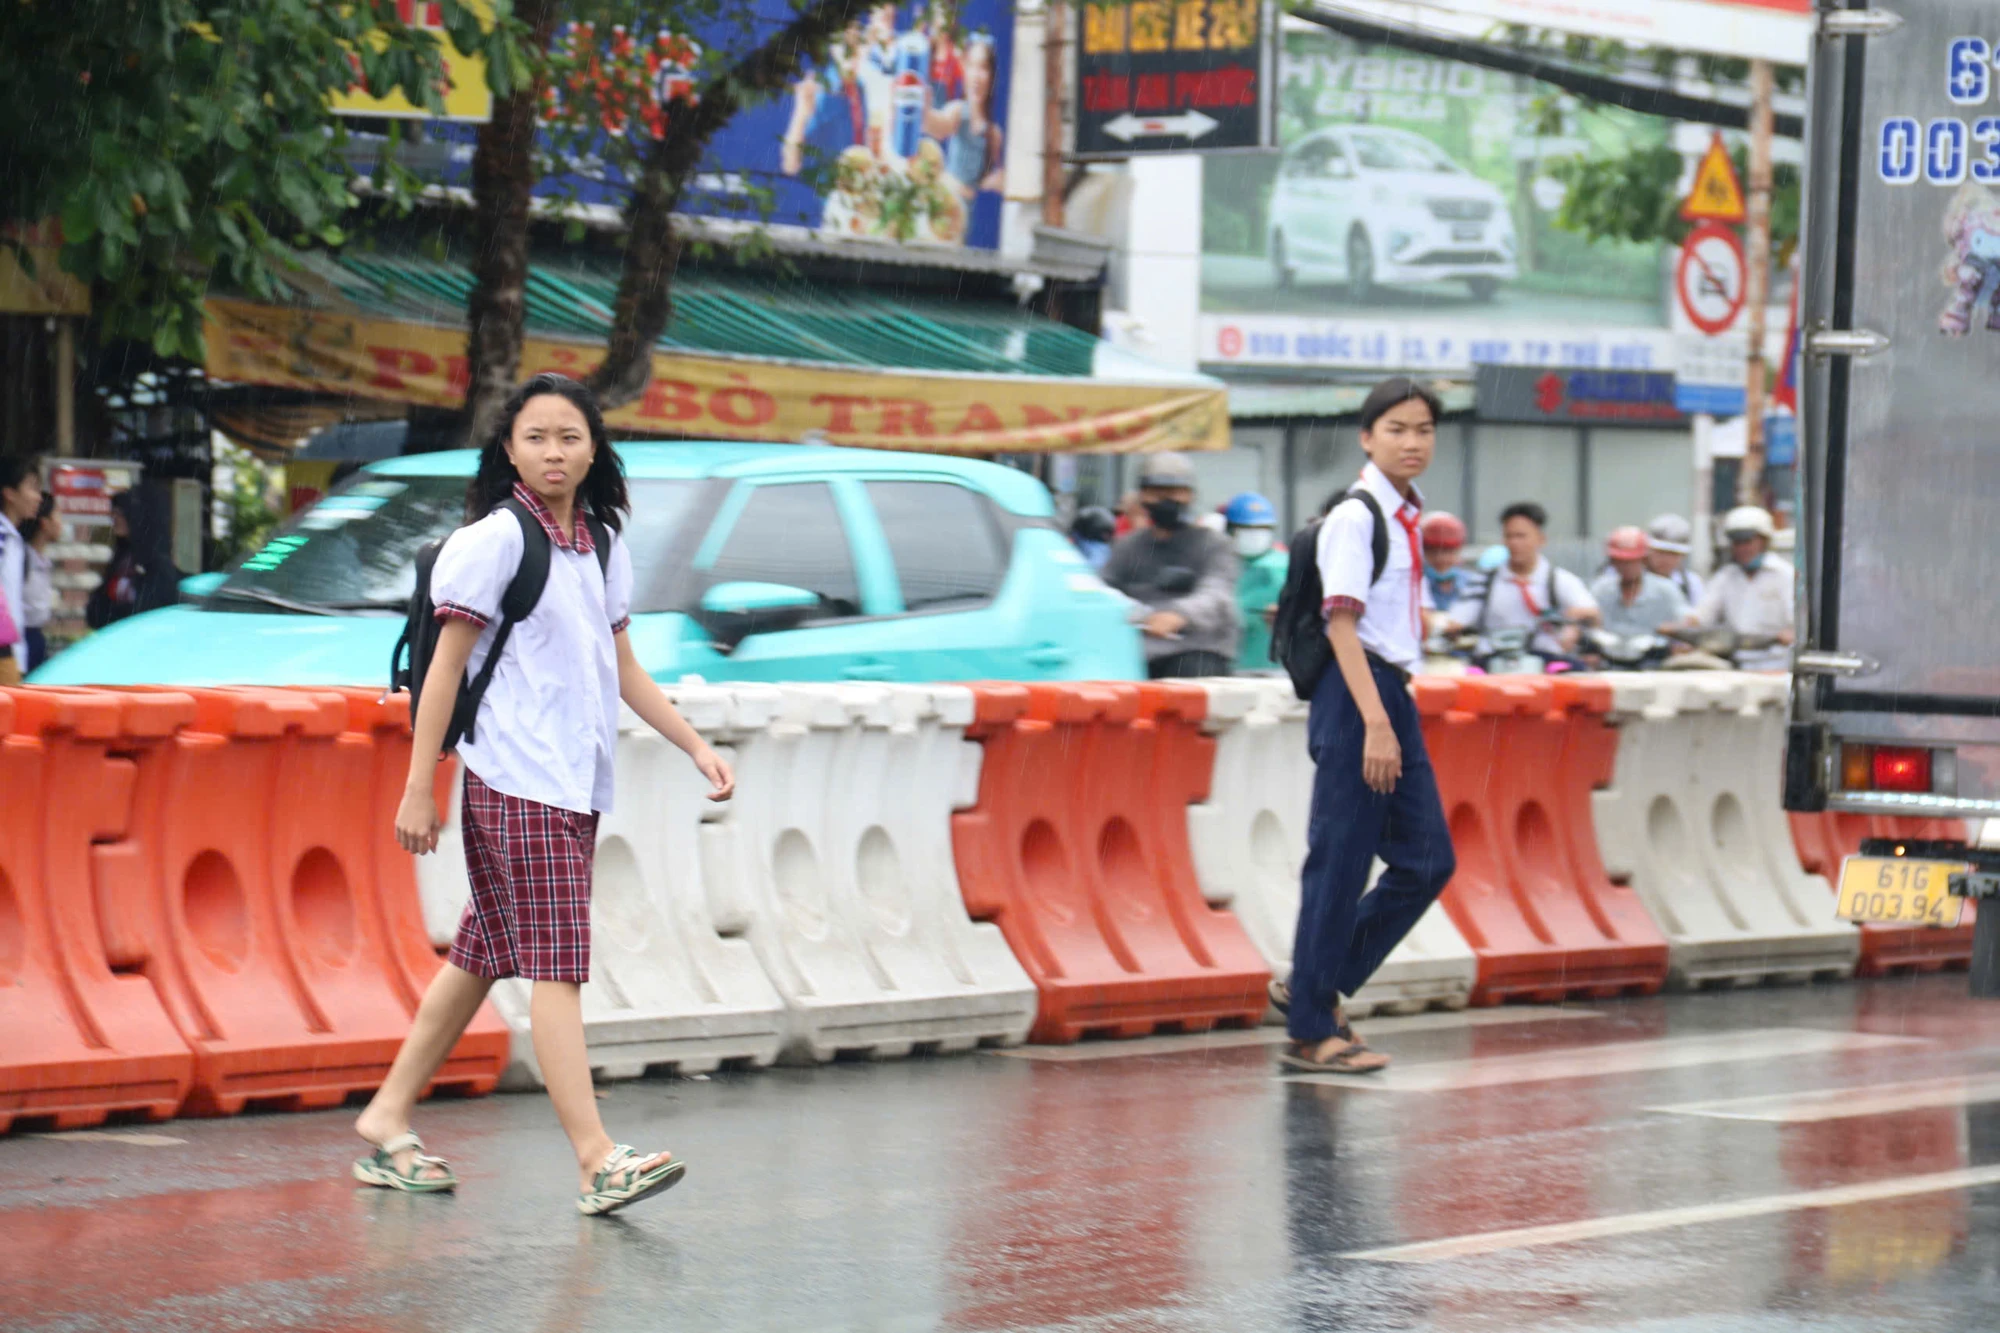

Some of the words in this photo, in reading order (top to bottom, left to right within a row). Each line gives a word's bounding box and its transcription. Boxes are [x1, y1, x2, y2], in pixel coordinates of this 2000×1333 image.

[1279, 52, 1487, 98] HYBRID
[635, 372, 778, 428] BÒ
[1878, 863, 1930, 891] 61G
[1851, 891, 1945, 924] 003.94
